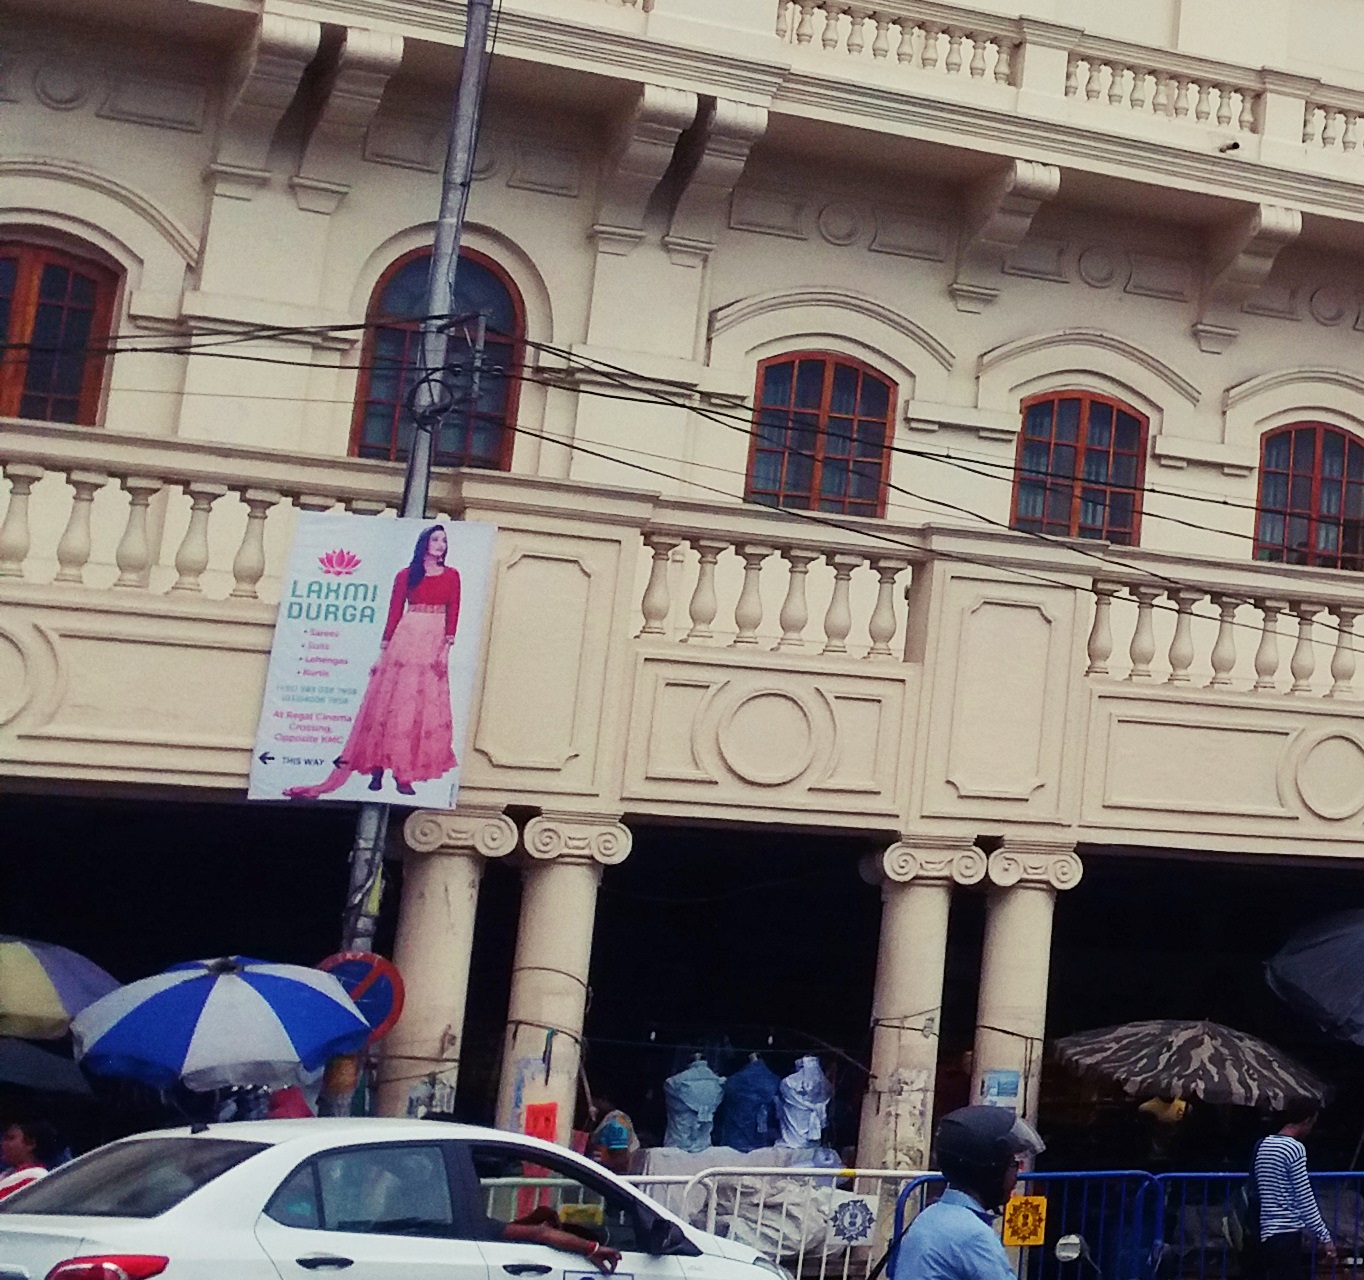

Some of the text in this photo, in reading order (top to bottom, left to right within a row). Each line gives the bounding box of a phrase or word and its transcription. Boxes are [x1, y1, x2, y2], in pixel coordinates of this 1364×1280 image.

[290, 579, 378, 602] LAXMI
[287, 601, 375, 623] DURGA
[282, 756, 325, 766] THIS WAY
